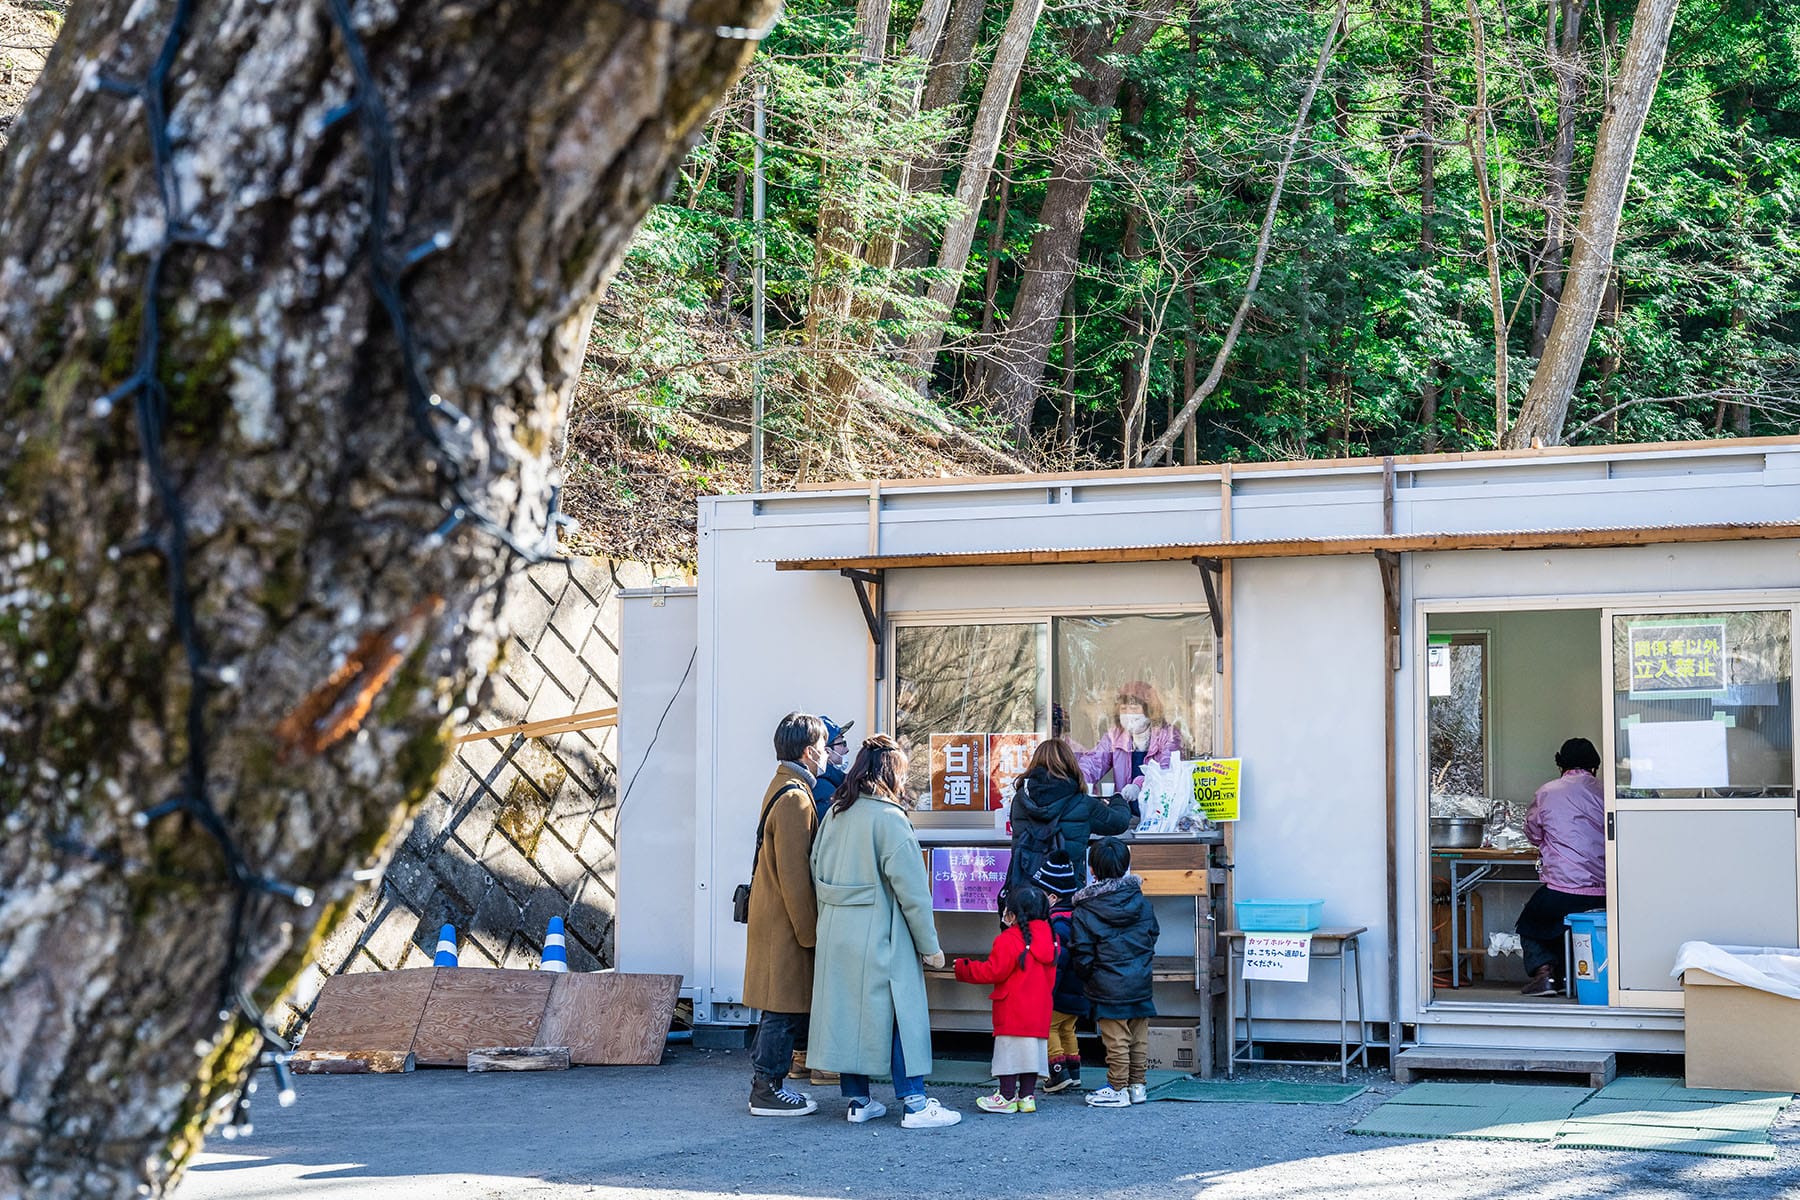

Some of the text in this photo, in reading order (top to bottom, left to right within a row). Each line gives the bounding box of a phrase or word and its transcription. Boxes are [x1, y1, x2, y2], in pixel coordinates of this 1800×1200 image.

[1634, 638, 1720, 657] 関係者以外
[1634, 657, 1716, 679] 立入禁止
[943, 743, 971, 805] 甘酒
[1248, 937, 1298, 947] カップホルダー
[1247, 959, 1283, 968] てください。
